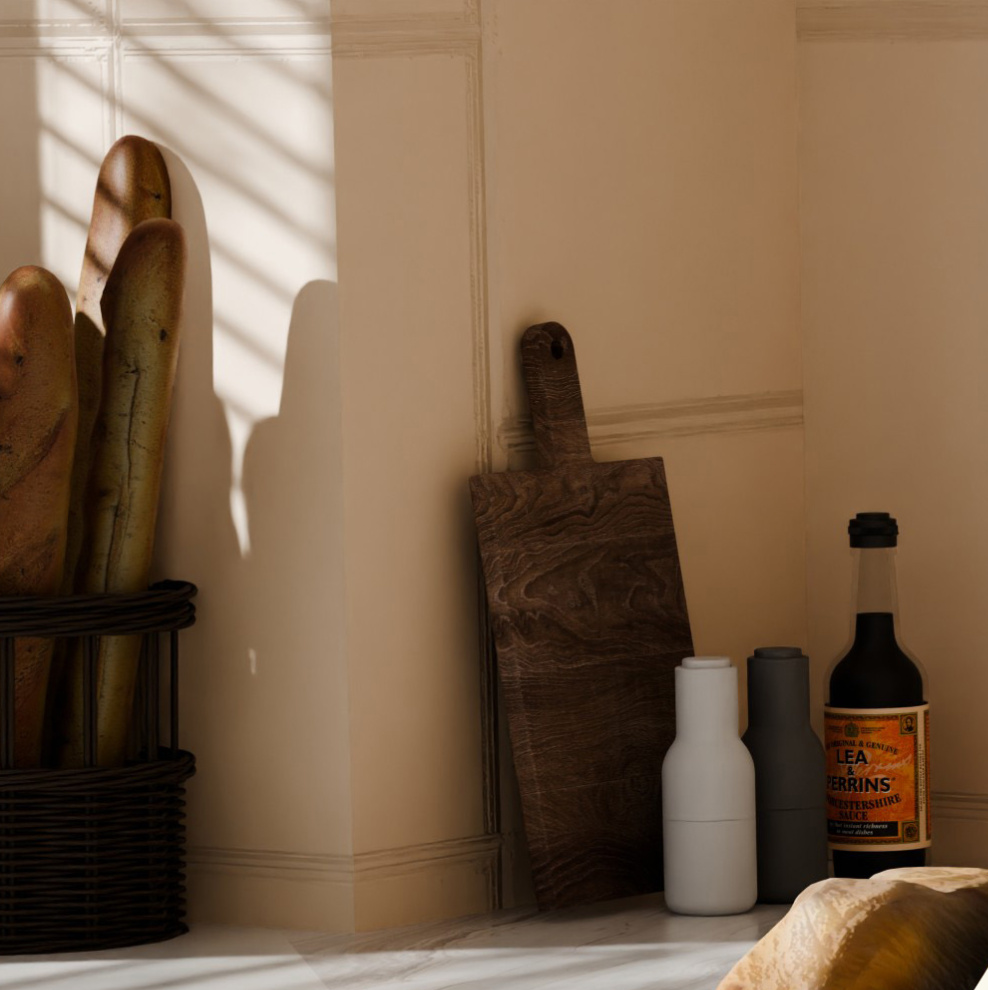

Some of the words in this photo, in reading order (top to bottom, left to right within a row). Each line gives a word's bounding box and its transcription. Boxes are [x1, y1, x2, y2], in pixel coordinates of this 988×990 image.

[858, 740, 864, 748] &
[866, 741, 899, 755] GENUINE
[836, 749, 869, 765] LEA
[847, 766, 855, 776] &
[826, 776, 891, 793] PERRINS
[838, 811, 869, 821] SAUCE
[862, 822, 889, 830] richness
